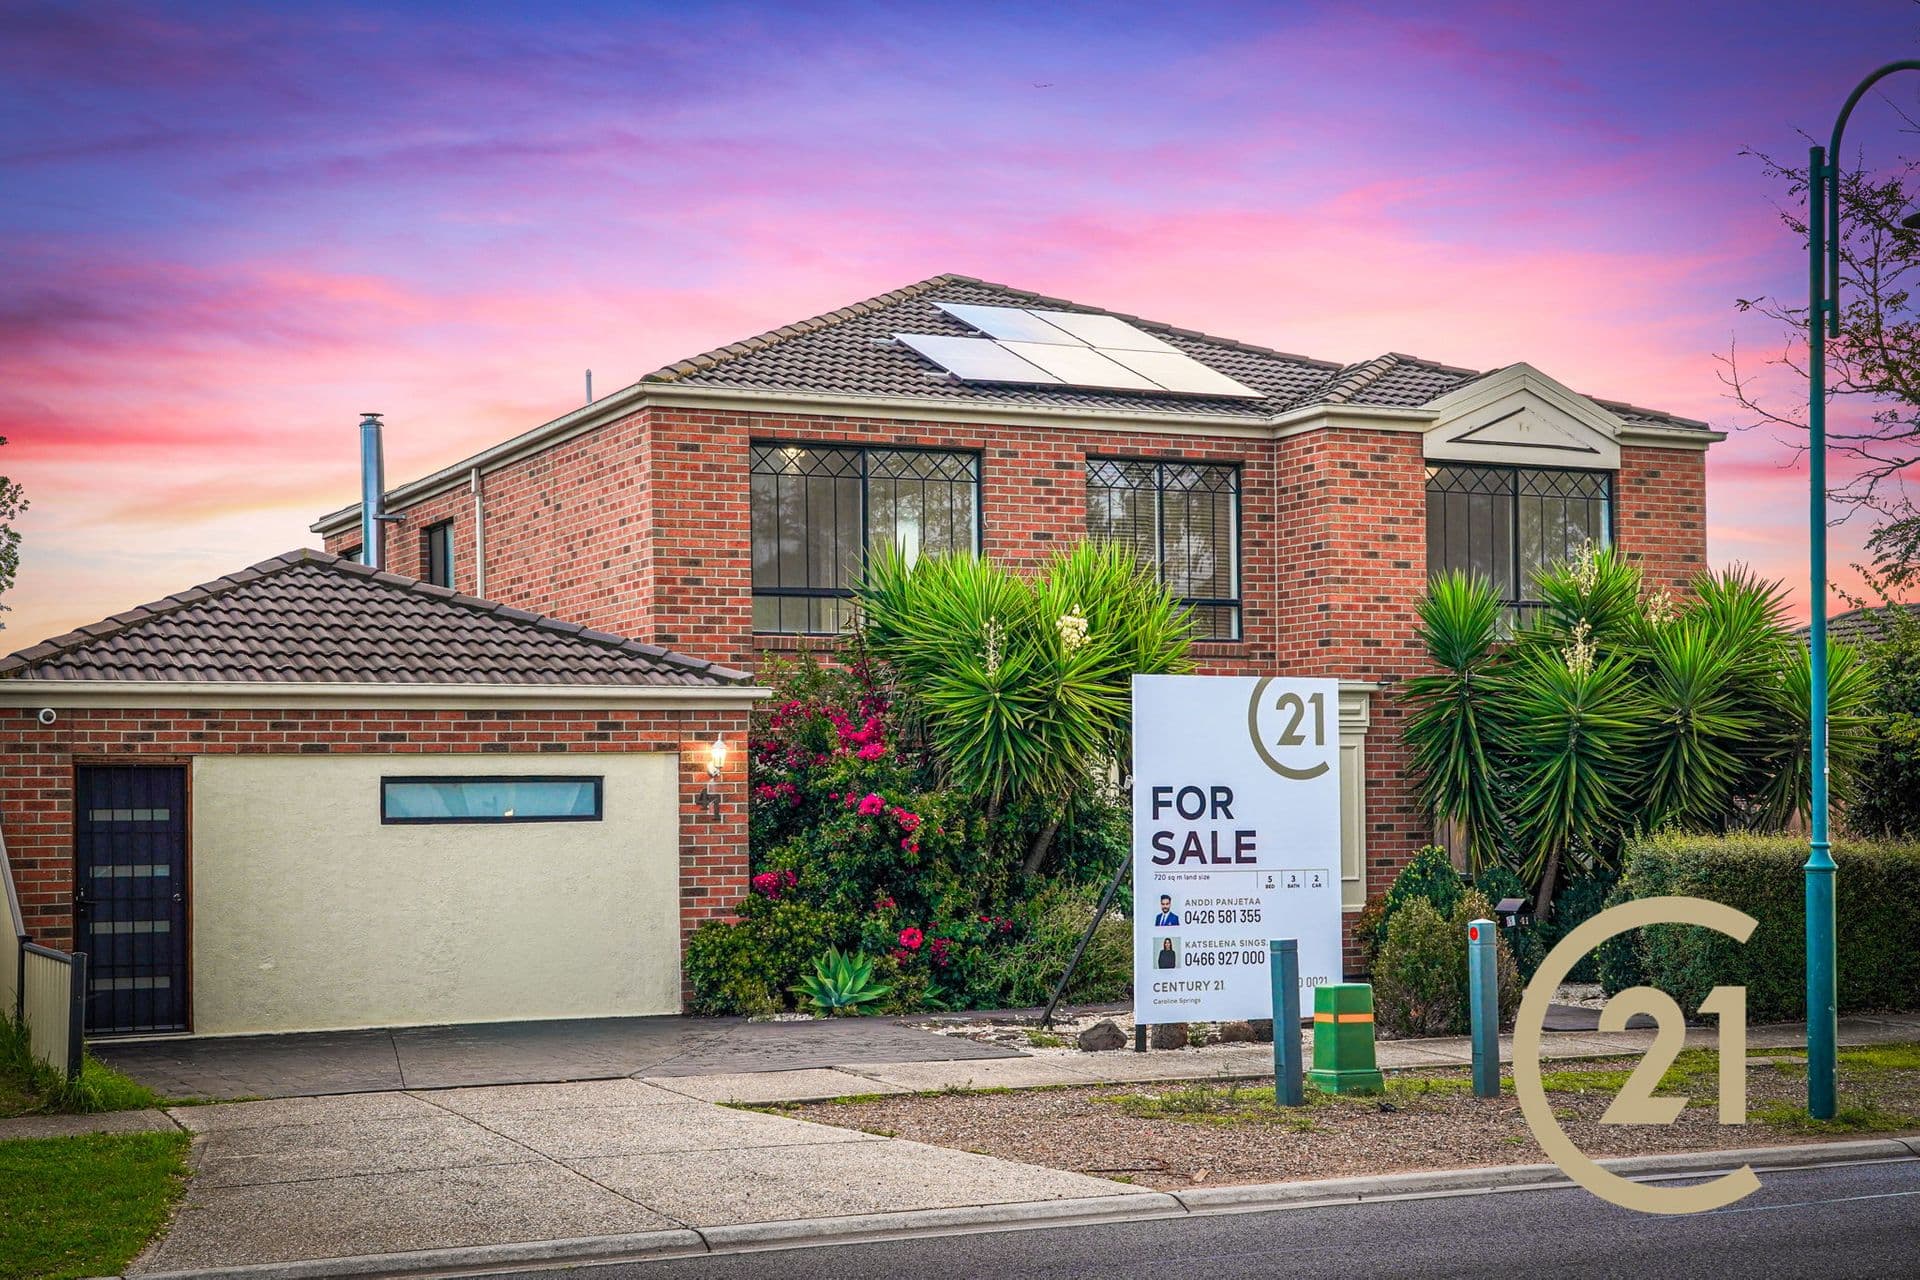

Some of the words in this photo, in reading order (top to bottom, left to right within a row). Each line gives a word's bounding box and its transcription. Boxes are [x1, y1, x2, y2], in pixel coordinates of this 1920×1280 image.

[1151, 785, 1235, 821] FOR
[1151, 829, 1257, 866] SALE
[1153, 873, 1167, 881] 720
[1168, 874, 1176, 882] sq
[1184, 873, 1198, 881] land
[1199, 873, 1211, 881] size
[1267, 875, 1274, 883] 5
[1290, 875, 1297, 883] 3
[1313, 874, 1320, 882] 2
[1184, 898, 1214, 907] ANDDI
[1215, 897, 1262, 906] PANJETAA
[1184, 910, 1215, 925] 0426
[1218, 909, 1237, 924] 581
[1239, 908, 1262, 923] 355
[1184, 940, 1237, 949] KATSELENA
[1239, 938, 1269, 948] SINGS
[1184, 951, 1216, 967] 0466
[1217, 951, 1240, 966] 927
[1242, 950, 1265, 965] 000
[1152, 980, 1211, 993] CENTURY
[1213, 979, 1225, 991] 21
[1178, 997, 1202, 1005] Springs
